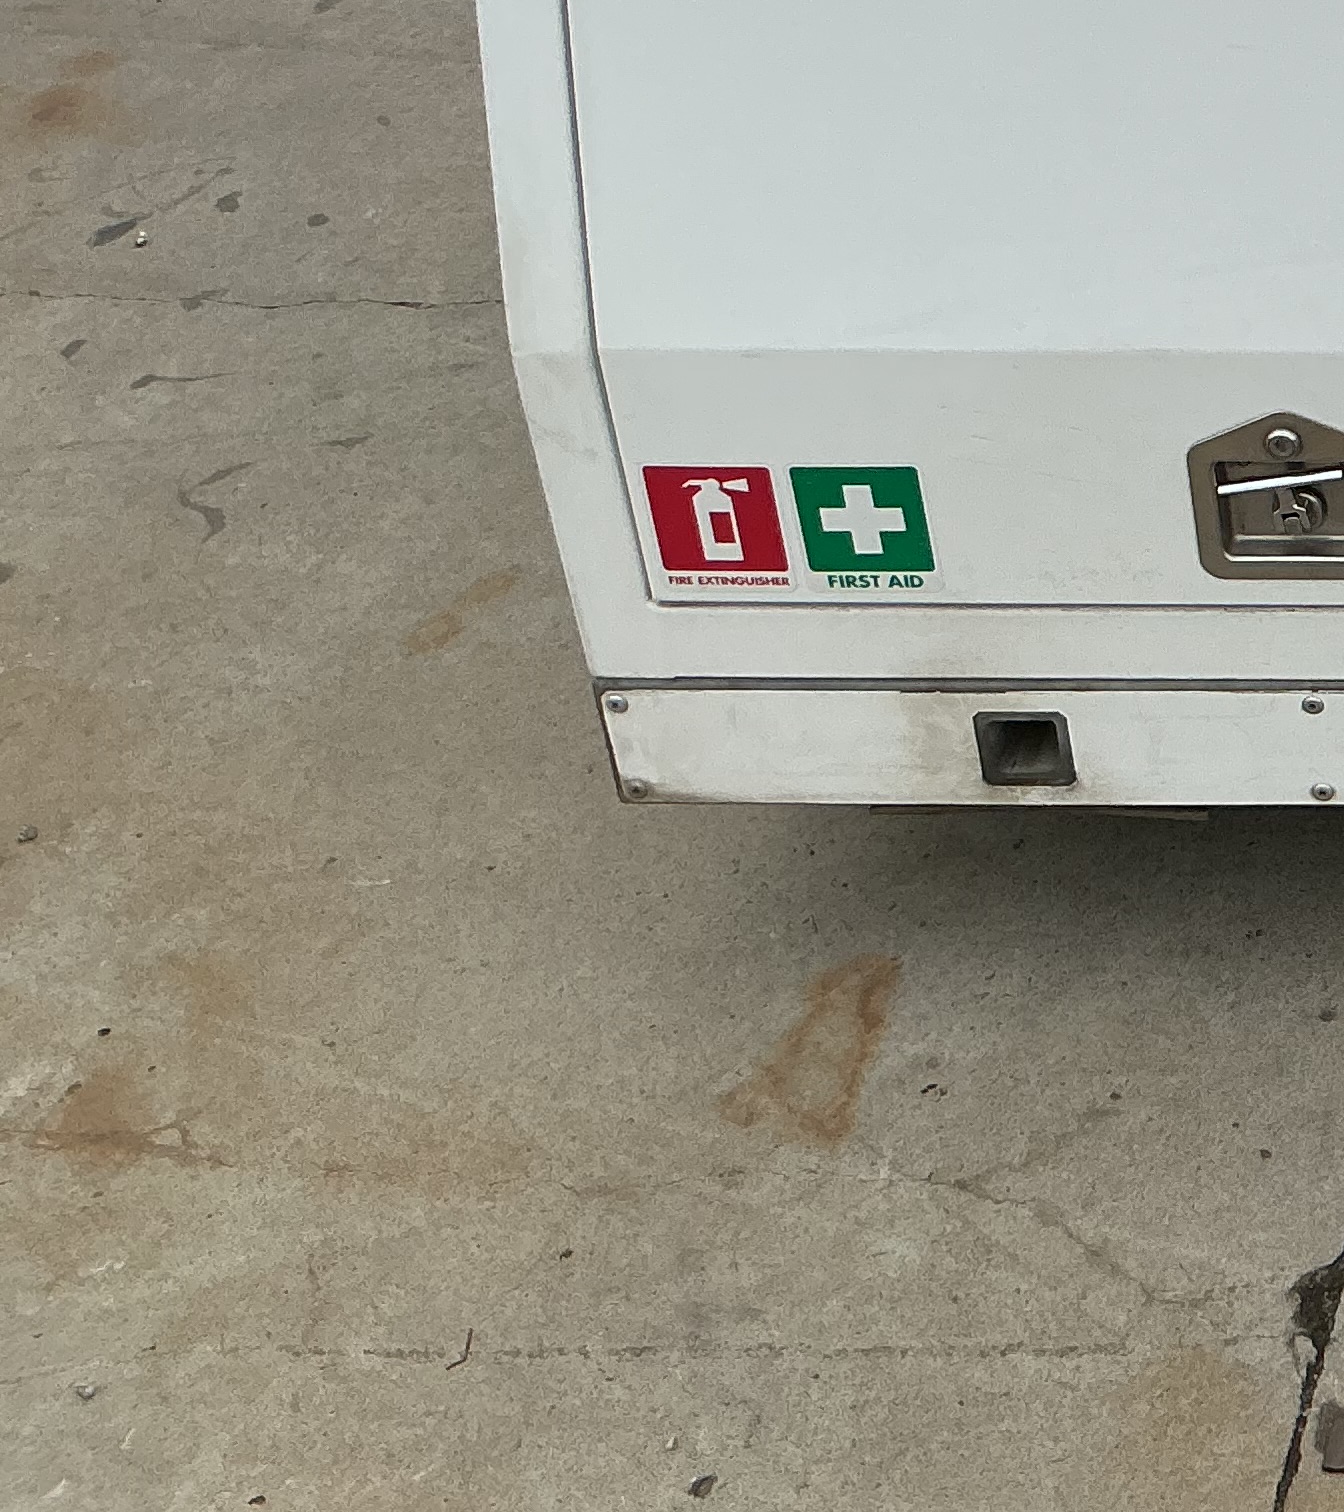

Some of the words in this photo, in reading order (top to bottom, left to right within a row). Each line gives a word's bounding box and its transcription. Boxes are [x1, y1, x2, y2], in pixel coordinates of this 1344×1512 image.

[668, 575, 694, 586] FIRE
[697, 575, 791, 587] EXTINGUISHER
[827, 574, 881, 589] FIRST
[888, 574, 924, 589] AID
